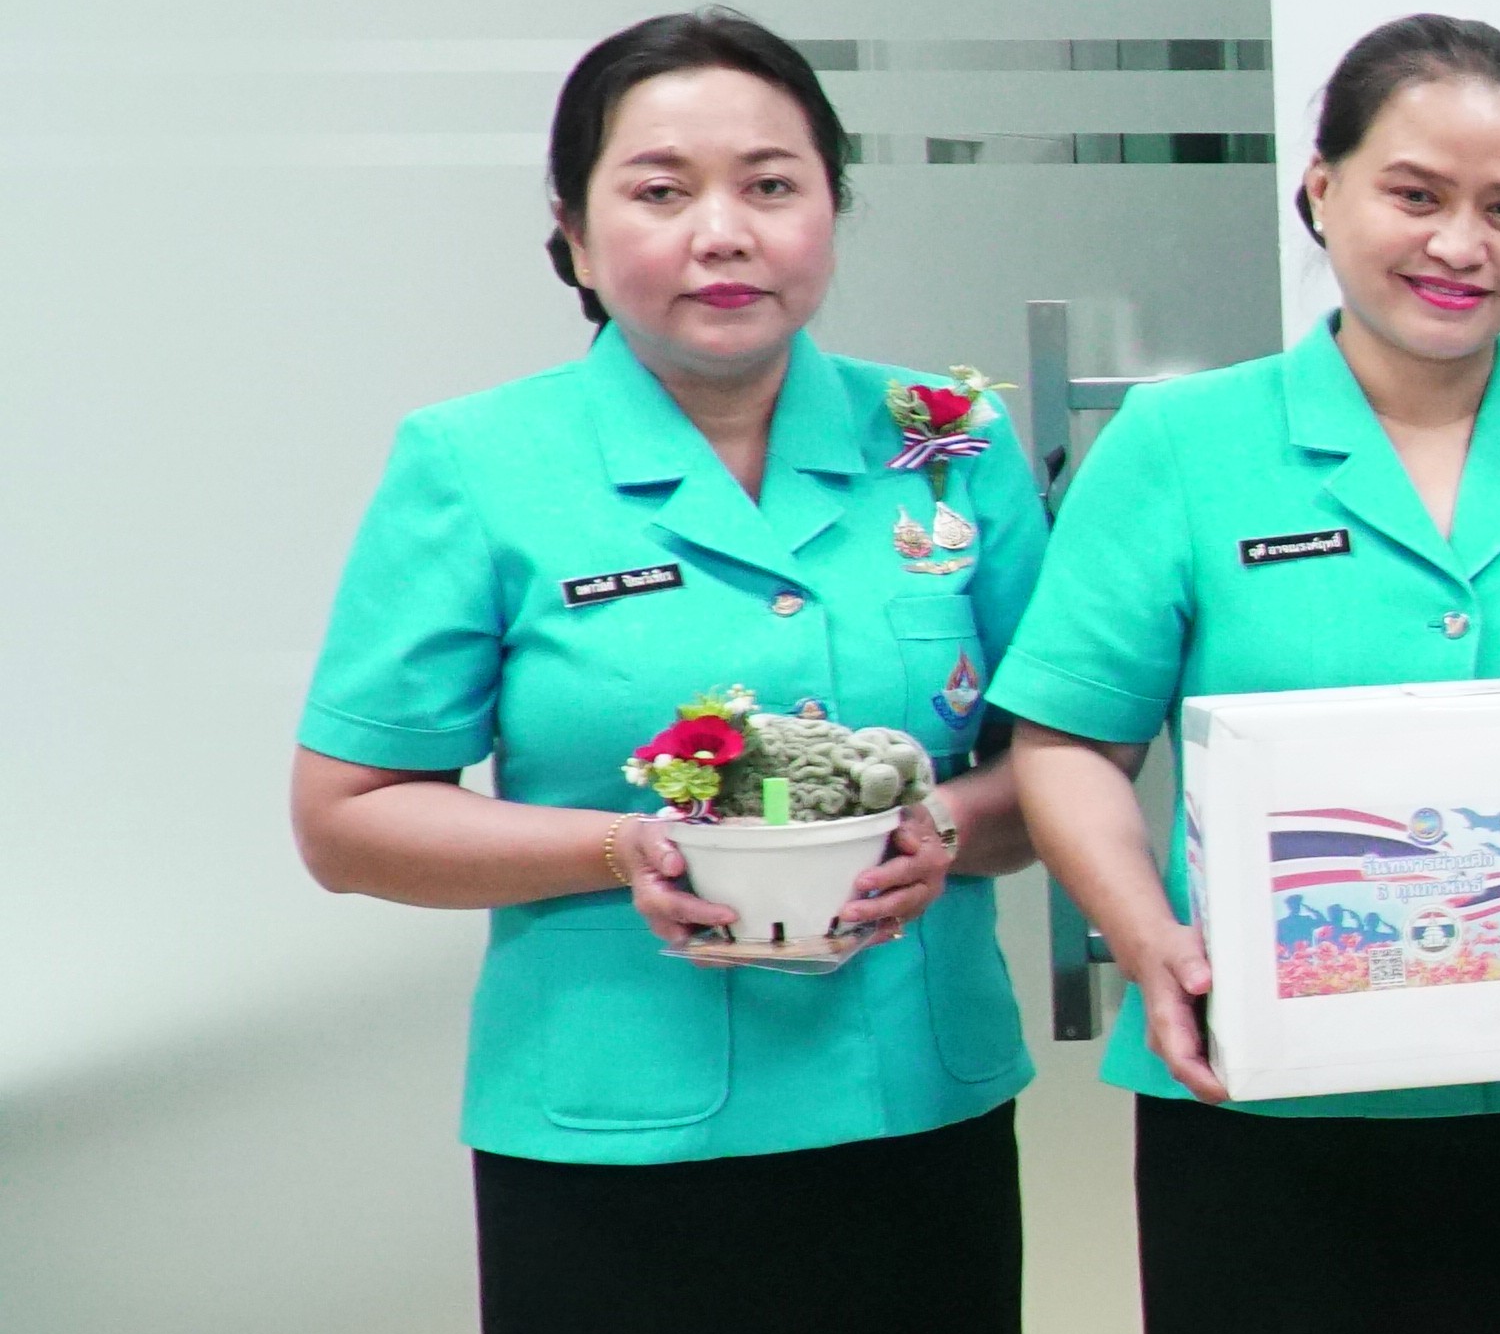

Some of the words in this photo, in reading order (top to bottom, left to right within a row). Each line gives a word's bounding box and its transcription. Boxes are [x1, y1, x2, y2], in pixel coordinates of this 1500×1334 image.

[1363, 849, 1494, 875] วันทหารผ่านศึก
[1377, 884, 1388, 900] 3
[1396, 872, 1483, 904] กุมภาพันธ์
